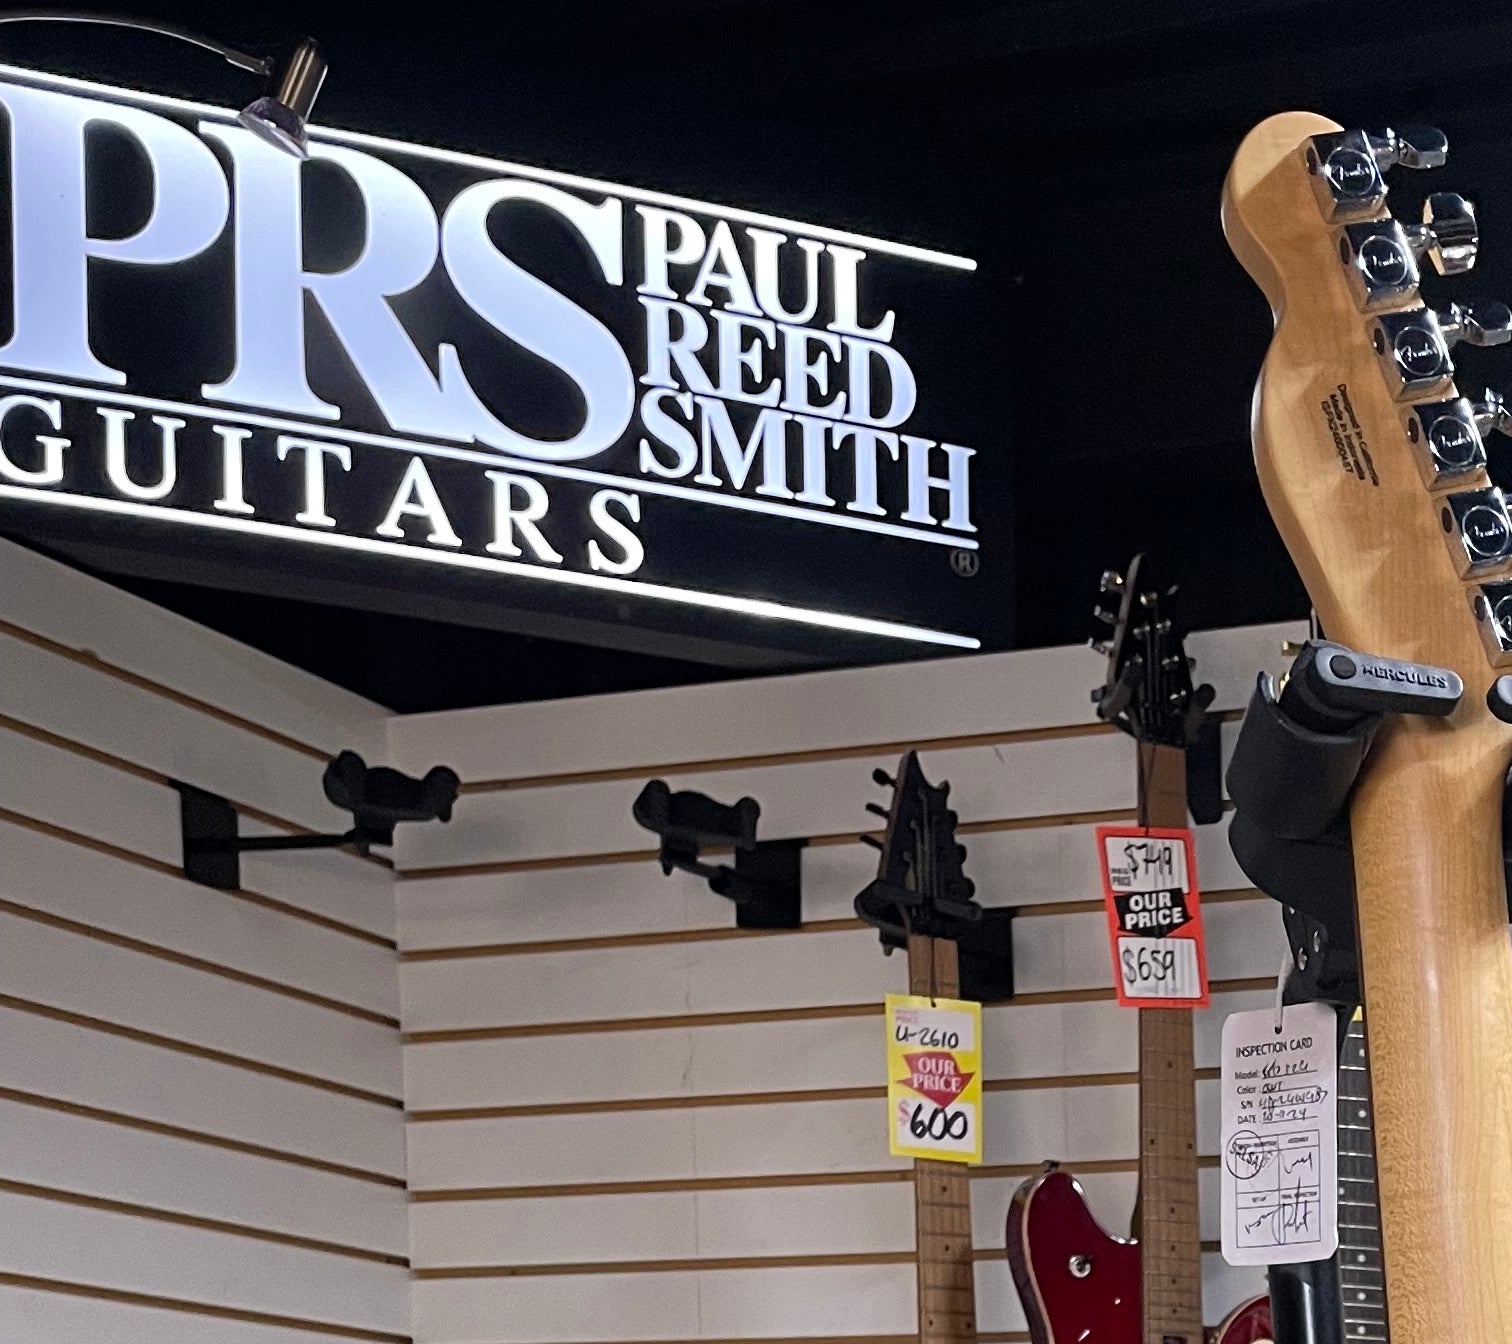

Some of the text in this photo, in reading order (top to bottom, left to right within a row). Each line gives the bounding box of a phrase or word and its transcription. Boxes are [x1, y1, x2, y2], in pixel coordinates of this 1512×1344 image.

[0, 82, 636, 463] PRS
[635, 203, 895, 343] PAUL
[638, 295, 917, 428] REED
[639, 387, 978, 533] SMITH
[0, 394, 645, 575] GUITARS
[1361, 662, 1448, 691] HERCULES
[1124, 907, 1185, 930] PRICE
[1129, 891, 1173, 912] OUR
[1122, 946, 1177, 985] $659
[1235, 1037, 1313, 1058] INSPECTION CARD
[917, 1056, 956, 1076] OUR
[912, 1074, 963, 1094] PRICE
